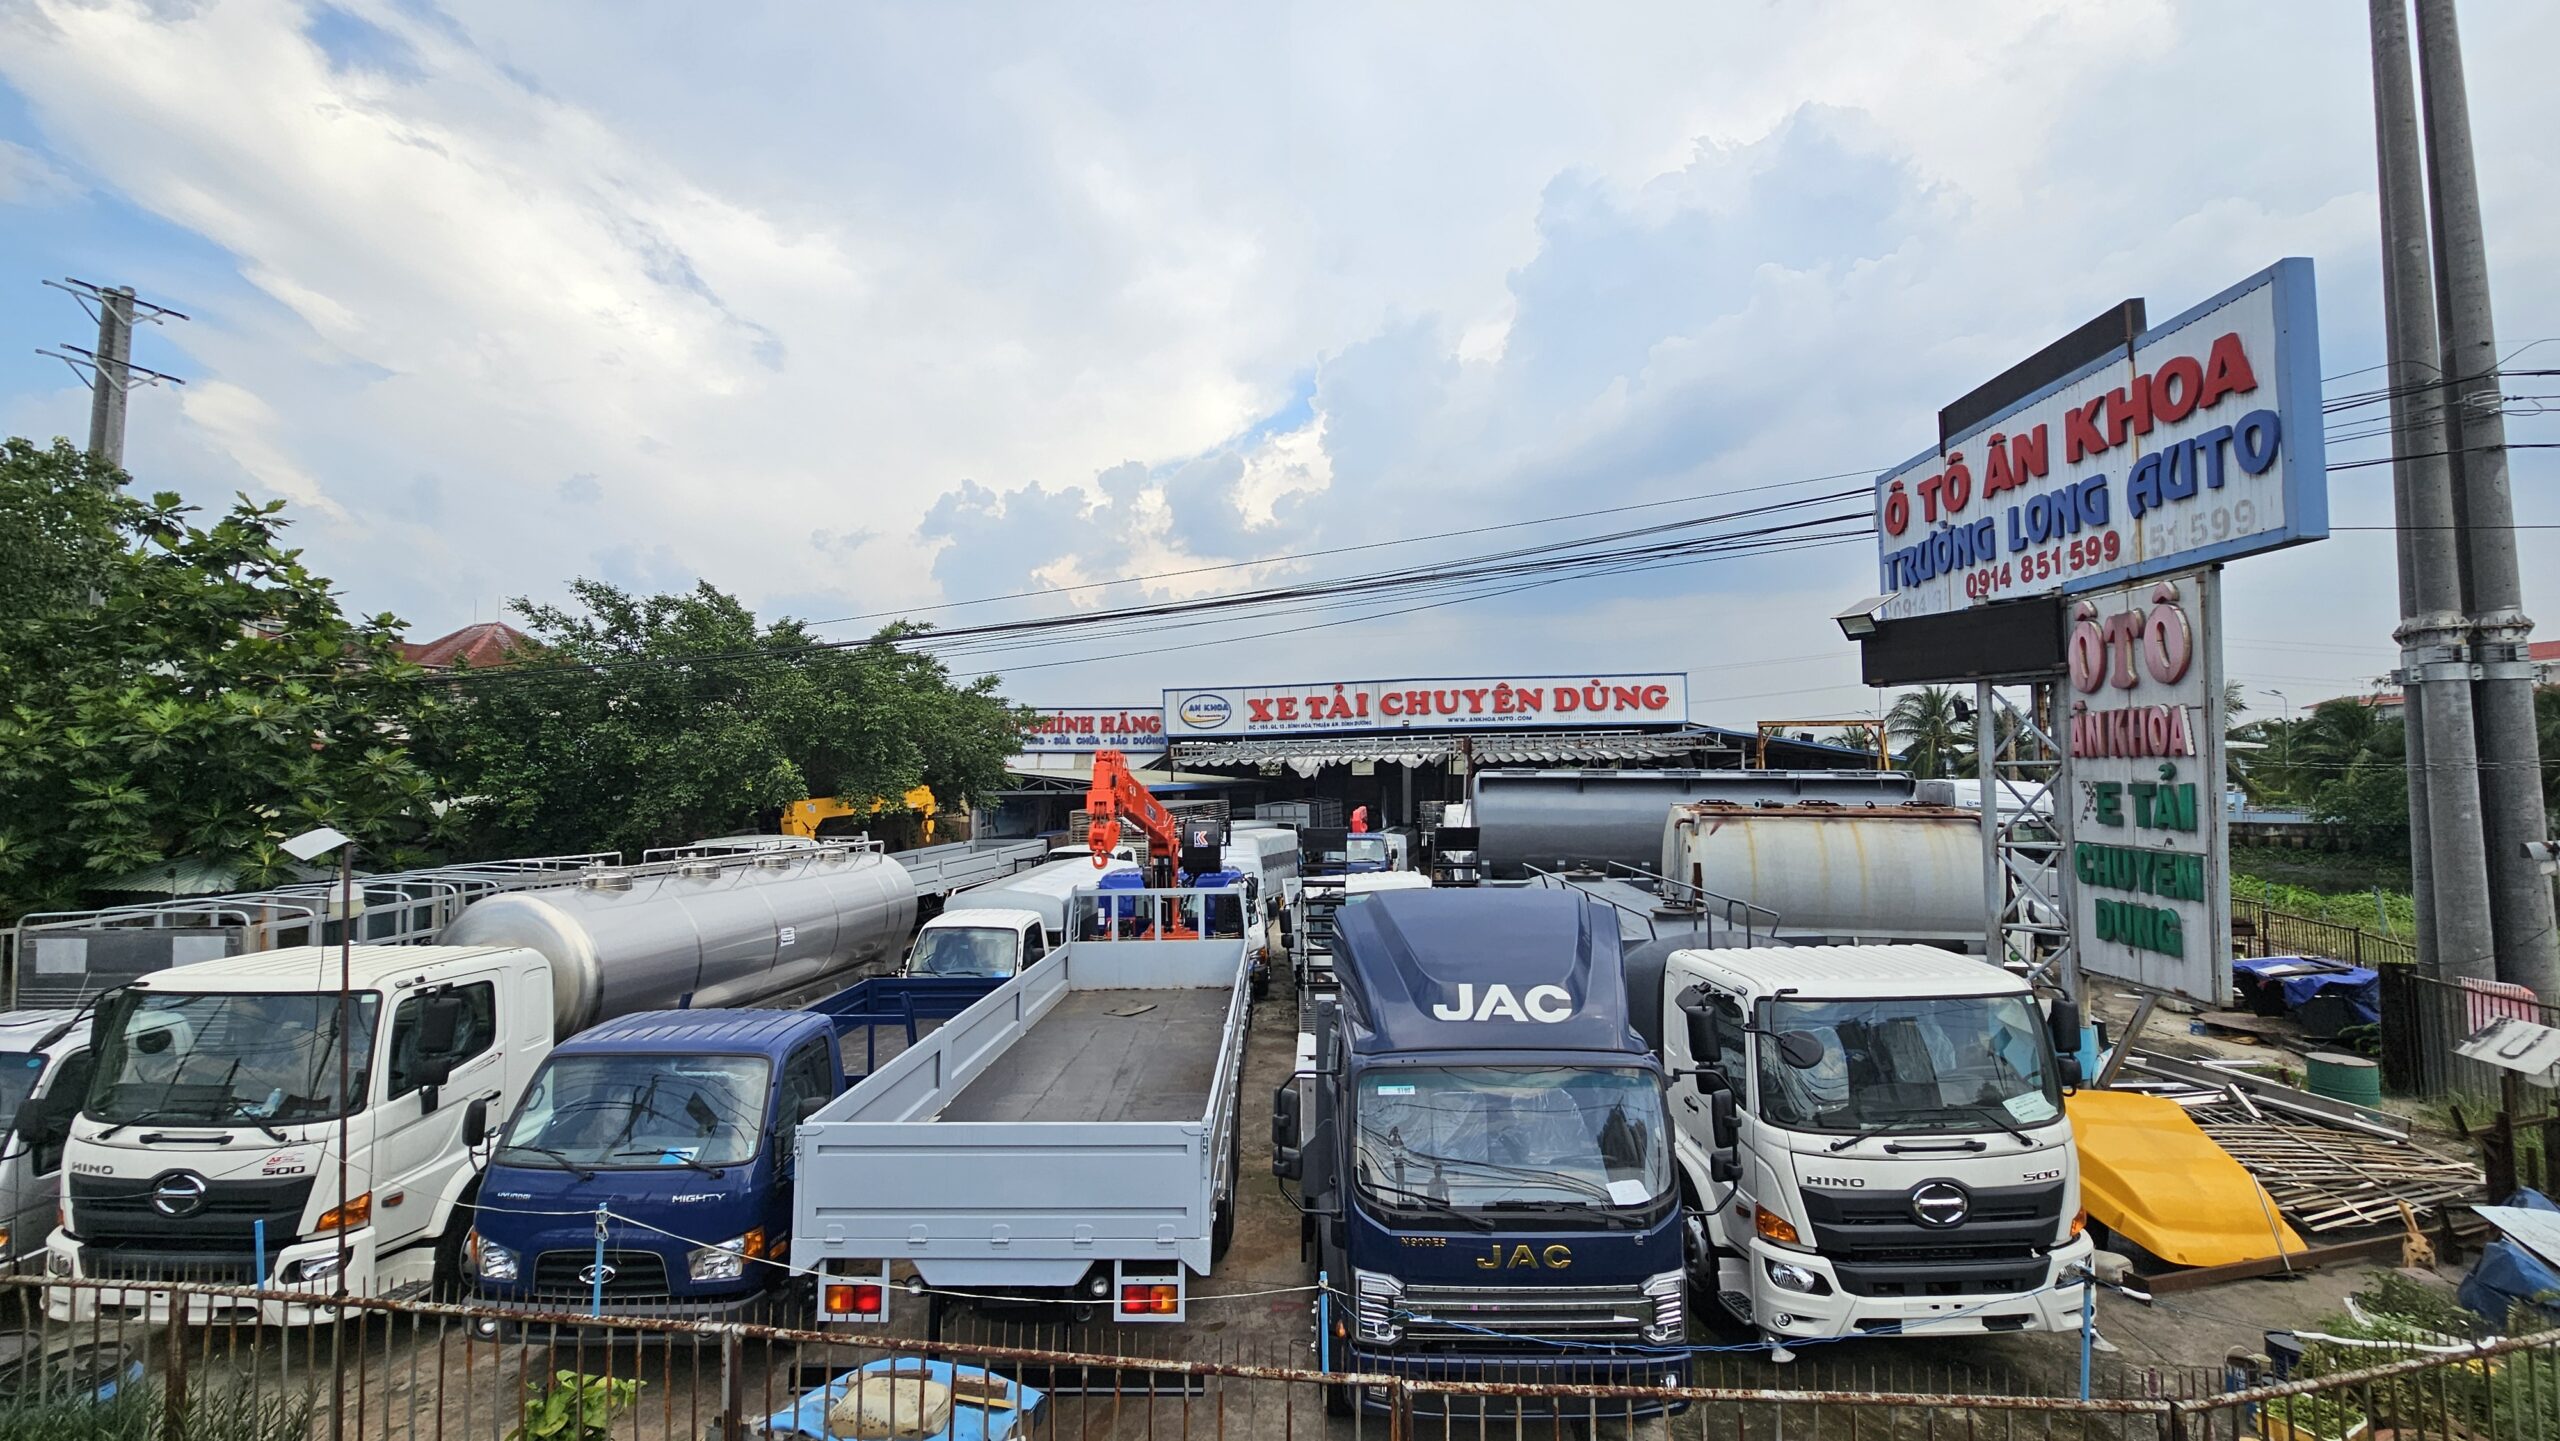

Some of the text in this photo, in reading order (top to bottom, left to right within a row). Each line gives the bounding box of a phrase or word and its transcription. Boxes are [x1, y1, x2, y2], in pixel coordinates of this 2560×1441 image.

[1884, 332, 2258, 536] Ô TÔ ÂN KHOA
[2008, 473, 2109, 552] LONG
[2127, 409, 2281, 519] AUTO
[1966, 562, 2012, 599] 0914
[2021, 546, 2062, 583] 851
[2070, 530, 2121, 570] 599
[1247, 679, 1669, 722] XE TẢI CHUYÊN DÙNG
[2108, 704, 2196, 759] KHOA
[1433, 983, 1573, 1023] JAC
[72, 1161, 114, 1175] HINO
[262, 1165, 306, 1176] 500
[1807, 1175, 1865, 1188] HINO
[2023, 1169, 2060, 1182] 500
[672, 1193, 727, 1203] MIGHTY
[1476, 1244, 1572, 1270] JAC
